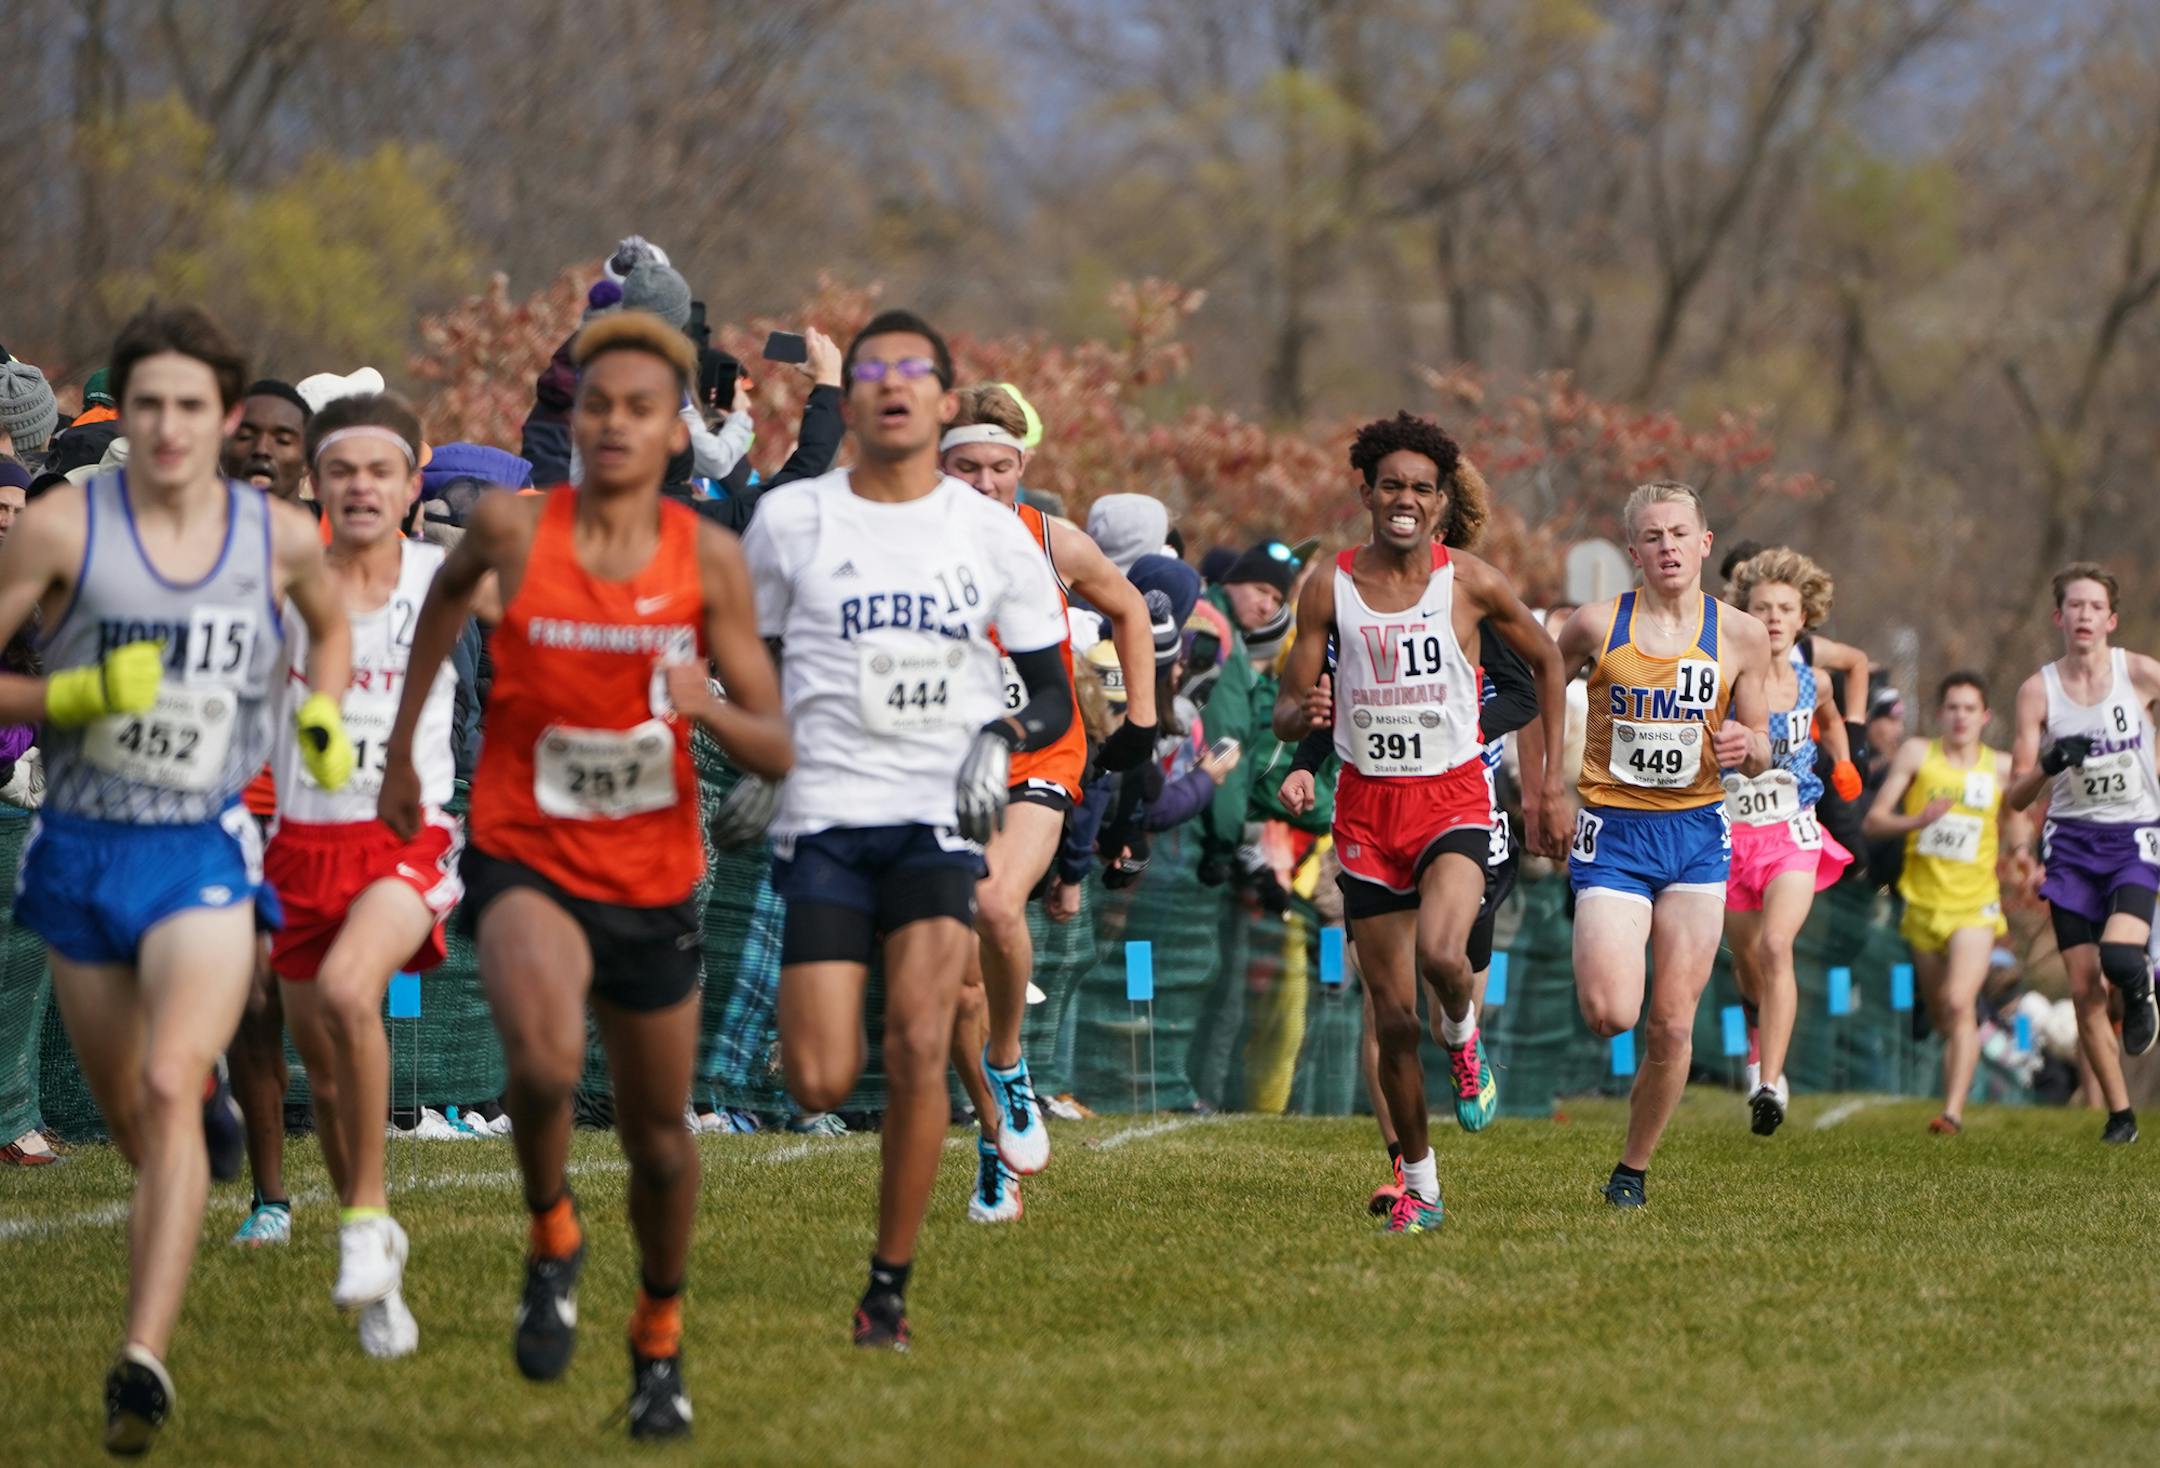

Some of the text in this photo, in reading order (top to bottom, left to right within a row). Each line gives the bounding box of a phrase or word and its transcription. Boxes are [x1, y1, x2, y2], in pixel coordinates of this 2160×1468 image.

[935, 565, 979, 613] 18
[195, 621, 247, 672] 15
[1402, 637, 1441, 677] 19
[887, 679, 948, 710] 444
[1351, 683, 1448, 707] CARDINALS
[1679, 665, 1715, 703] 18
[1376, 714, 1414, 726] MSHSL
[2113, 705, 2128, 733] 8
[117, 717, 199, 761] 452
[1368, 733, 1422, 760] 391
[1638, 731, 1676, 741] MSHSL
[1374, 763, 1423, 773] State Meet
[1629, 748, 1683, 775] 449
[2083, 772, 2127, 796] 273
[1738, 790, 1779, 816] 301
[1573, 815, 1597, 854] 18
